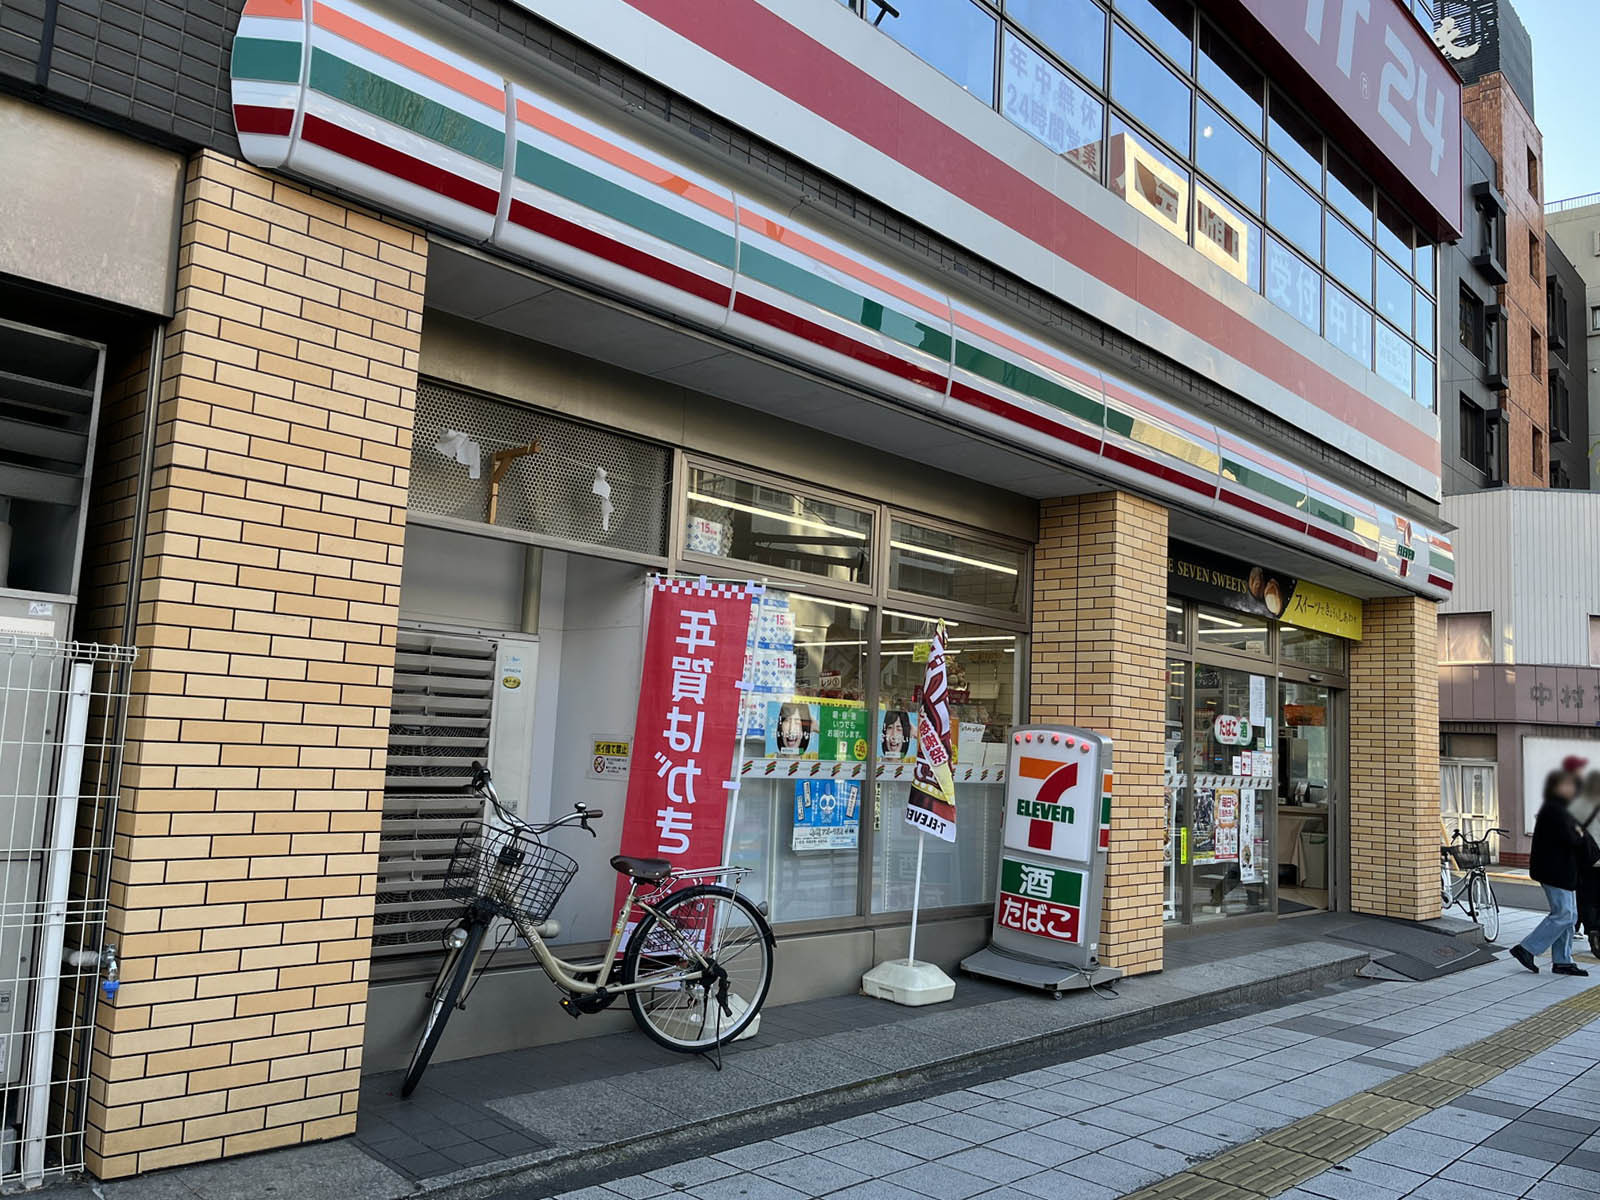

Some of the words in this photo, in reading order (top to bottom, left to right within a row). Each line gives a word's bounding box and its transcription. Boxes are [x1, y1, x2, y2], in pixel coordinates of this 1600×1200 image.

[1008, 42, 1097, 131] 年中無休
[1377, 24, 1445, 177] 24
[1177, 560, 1210, 585] SEVEN
[1211, 569, 1248, 594] SWEETS
[1219, 719, 1237, 737] たばこ
[1016, 798, 1075, 825] ELEVEN
[1018, 756, 1079, 851] 7
[1019, 864, 1056, 899] 酒
[1001, 896, 1073, 939] たばこ
